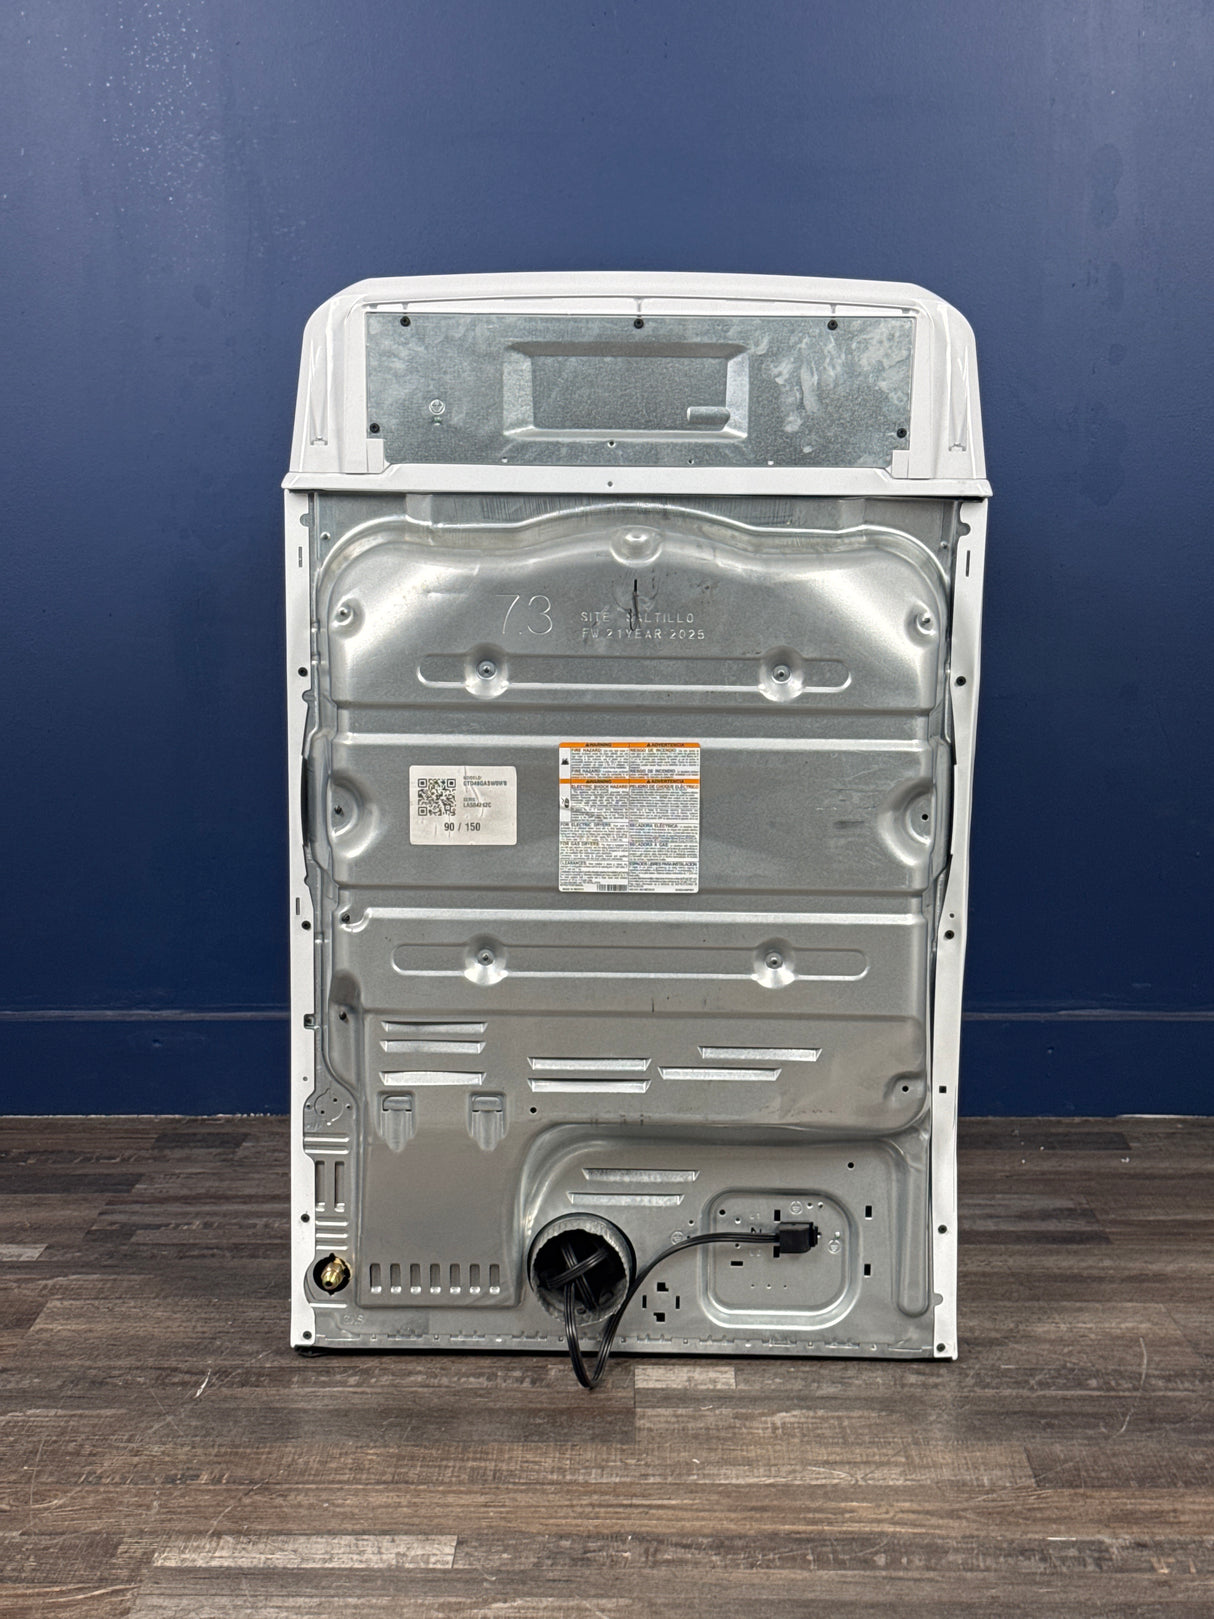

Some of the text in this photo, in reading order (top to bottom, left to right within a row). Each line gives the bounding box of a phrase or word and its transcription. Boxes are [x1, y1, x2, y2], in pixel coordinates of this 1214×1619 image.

[580, 611, 610, 622] SITE
[581, 628, 600, 639] FW
[669, 629, 705, 640] 2025
[444, 822, 481, 831] 90 / 150
